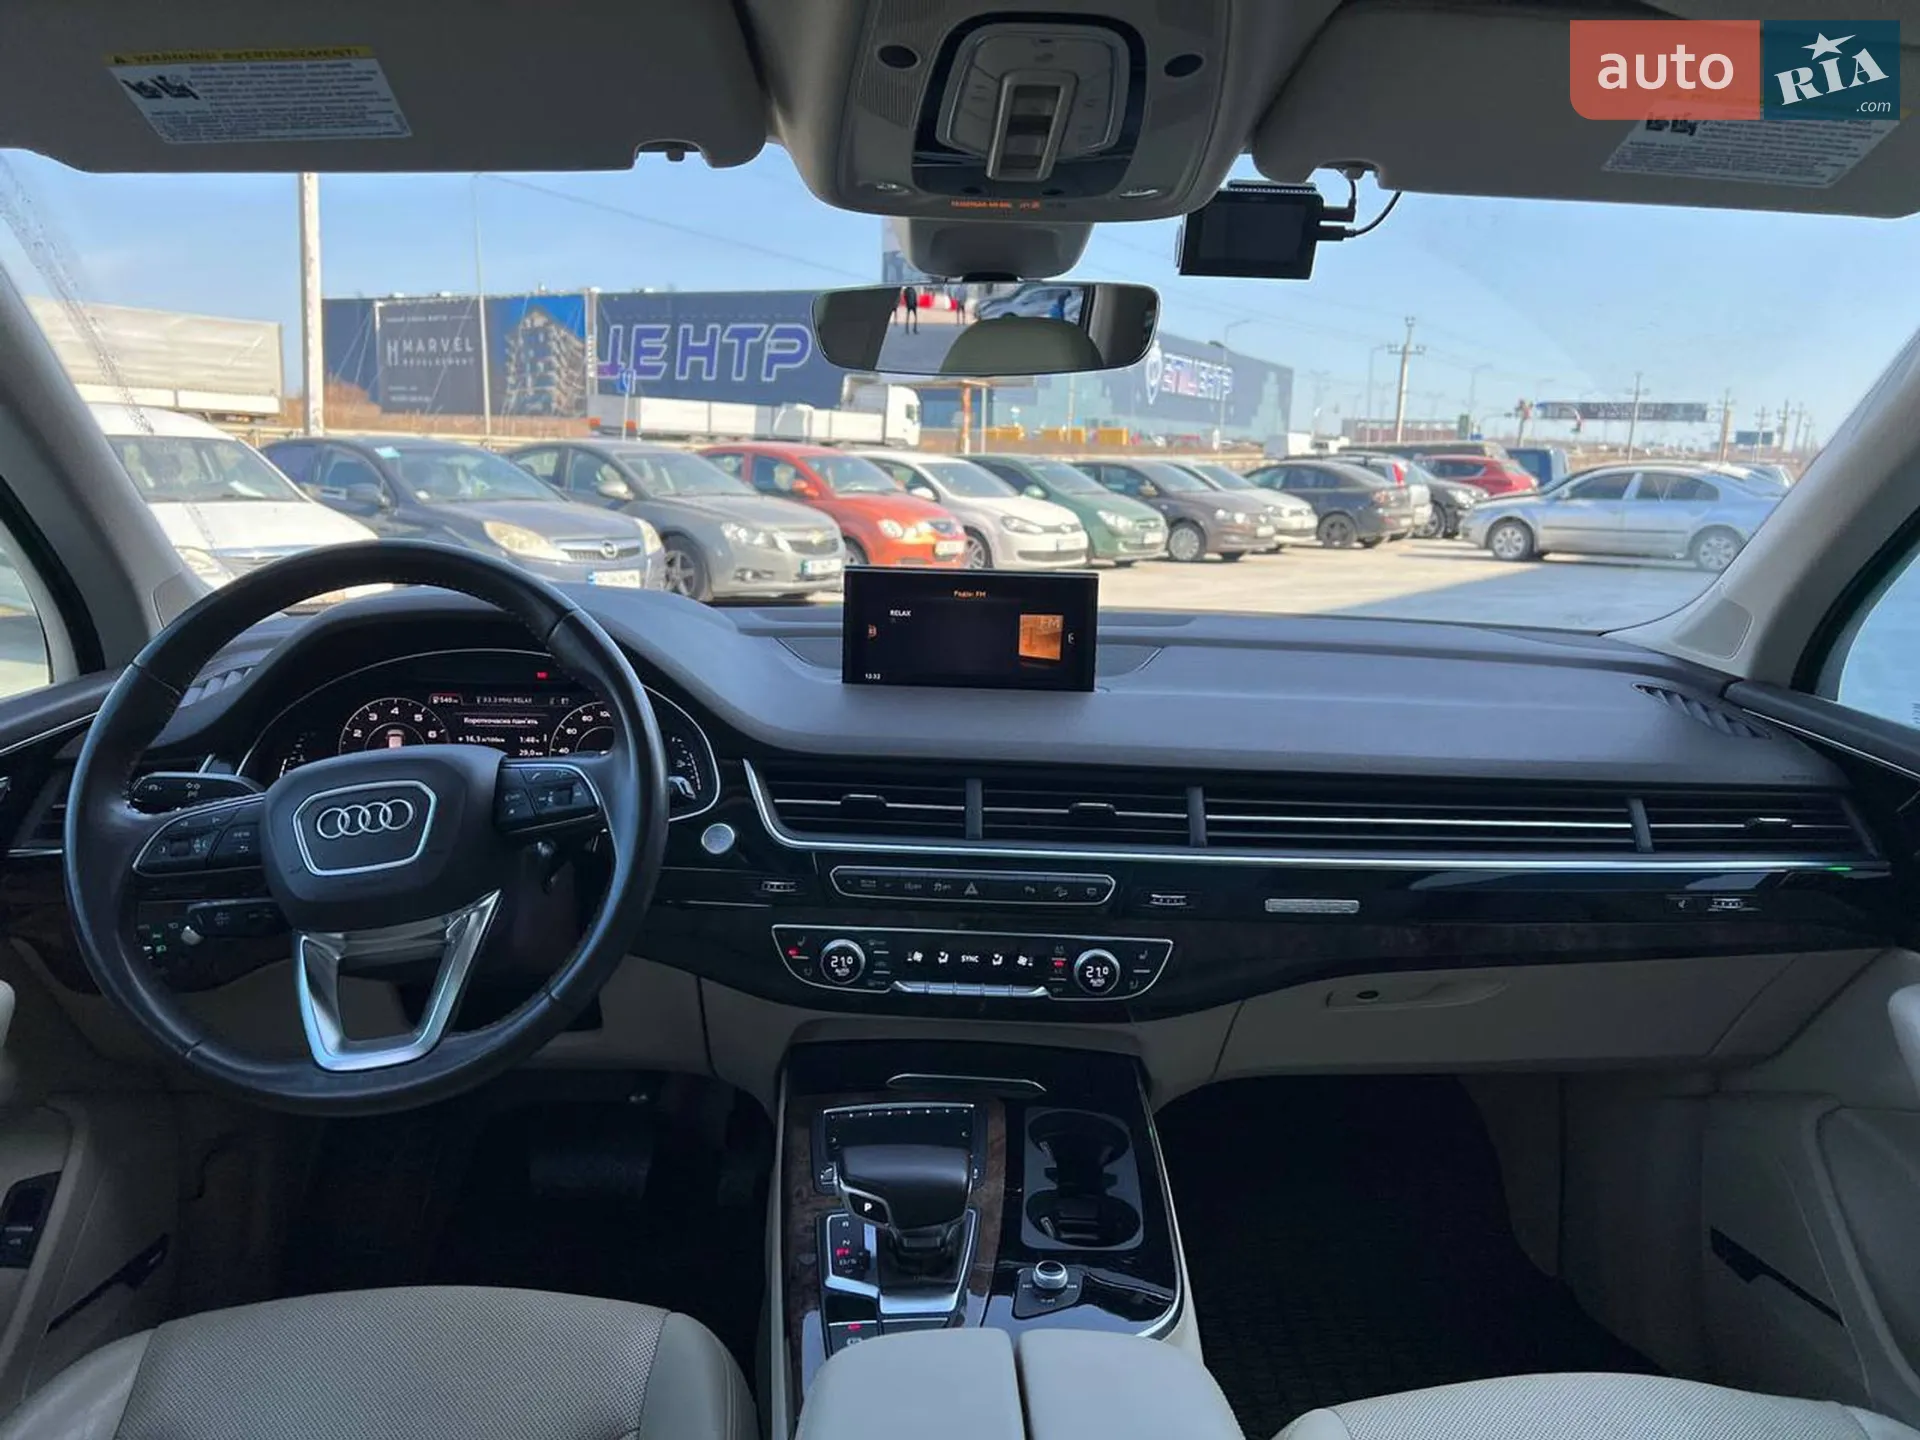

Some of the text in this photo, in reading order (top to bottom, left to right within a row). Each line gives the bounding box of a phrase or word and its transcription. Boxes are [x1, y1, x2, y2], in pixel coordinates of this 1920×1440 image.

[402, 336, 474, 353] MARVEL
[889, 609, 912, 618] RELAX
[390, 707, 400, 715] 4
[368, 713, 378, 722] 3
[961, 955, 979, 963] SYNC
[864, 1202, 873, 1212] P
